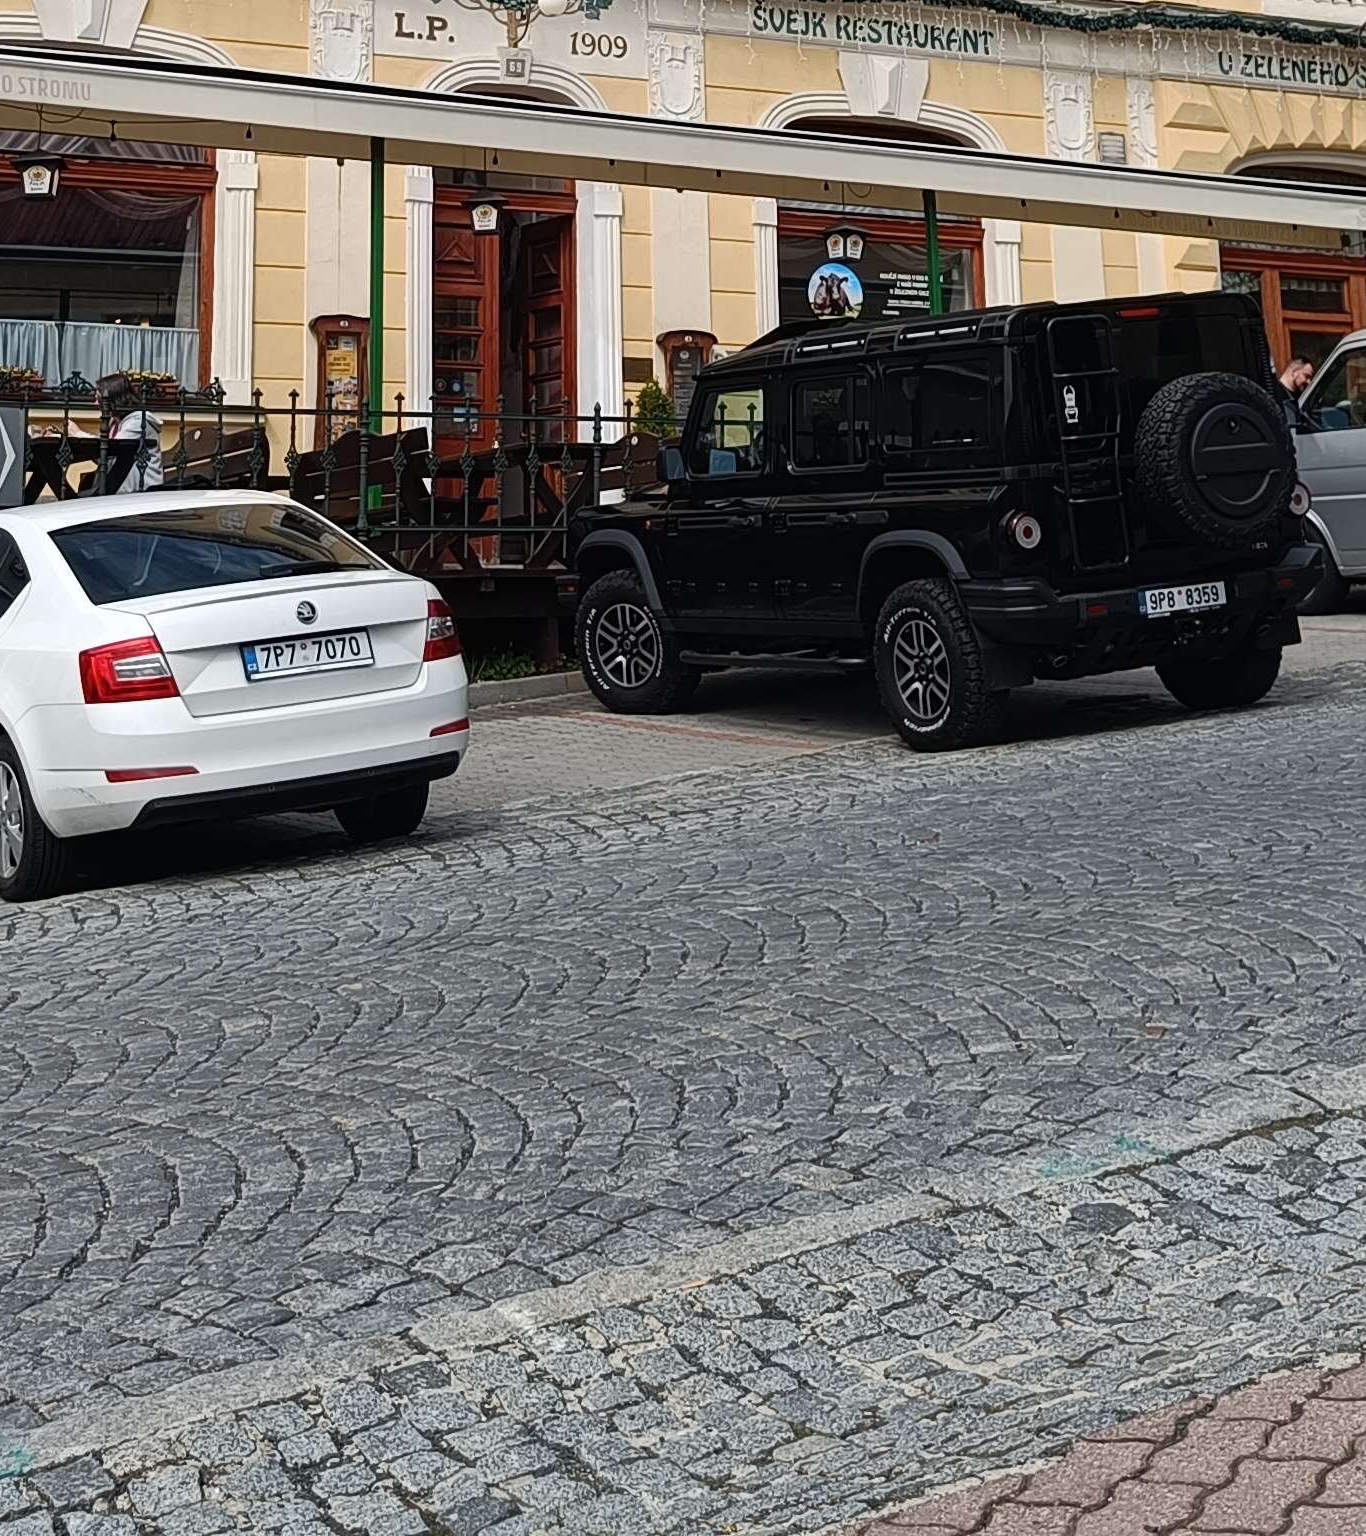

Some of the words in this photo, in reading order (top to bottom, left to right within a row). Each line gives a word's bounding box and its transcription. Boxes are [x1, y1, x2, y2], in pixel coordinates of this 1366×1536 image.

[394, 12, 455, 43] L.P.
[570, 31, 628, 59] 1909
[835, 15, 994, 56] RESTAURANT
[509, 61, 522, 73] 69
[1218, 50, 1233, 75] U
[1241, 53, 1349, 87] ZELENÉHO
[18, 77, 92, 101] STROMU
[1149, 590, 1176, 611] 9P8
[1185, 584, 1220, 606] 8359
[260, 643, 296, 669] 7P7
[311, 635, 361, 662] 7070
